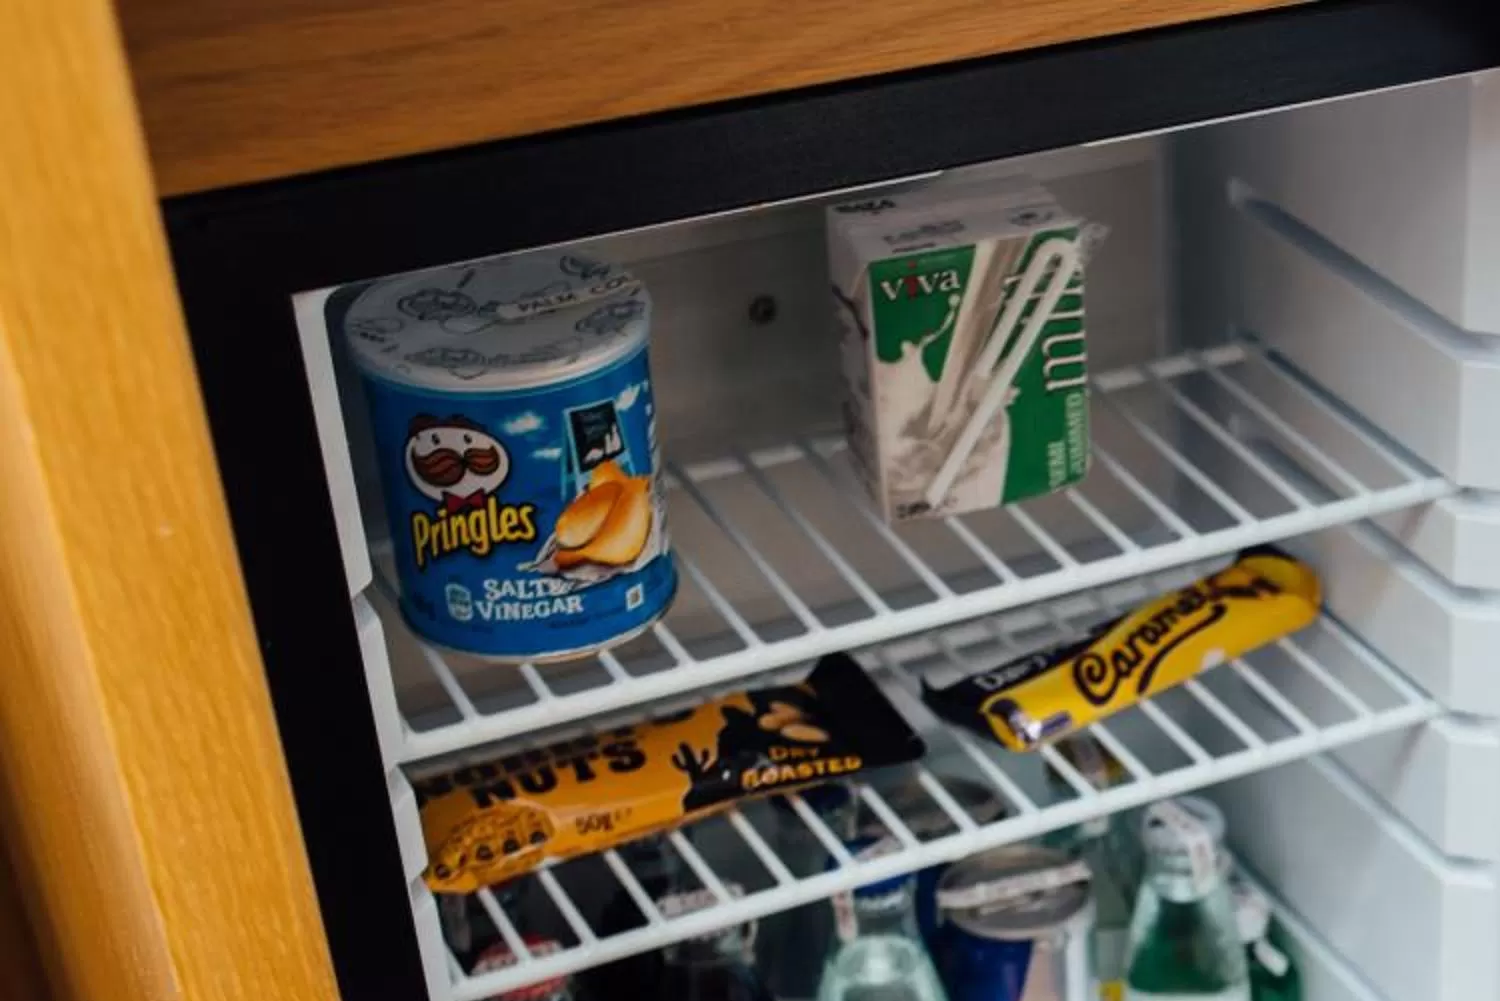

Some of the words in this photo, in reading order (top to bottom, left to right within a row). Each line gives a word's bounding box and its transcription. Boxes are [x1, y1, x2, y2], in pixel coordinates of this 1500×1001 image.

[881, 261, 961, 302] viva
[411, 497, 537, 568] Pringles
[475, 594, 585, 622] VINEGAR
[1072, 577, 1230, 705] Caramel
[471, 735, 647, 809] NUTS
[741, 755, 863, 789] ROASTED
